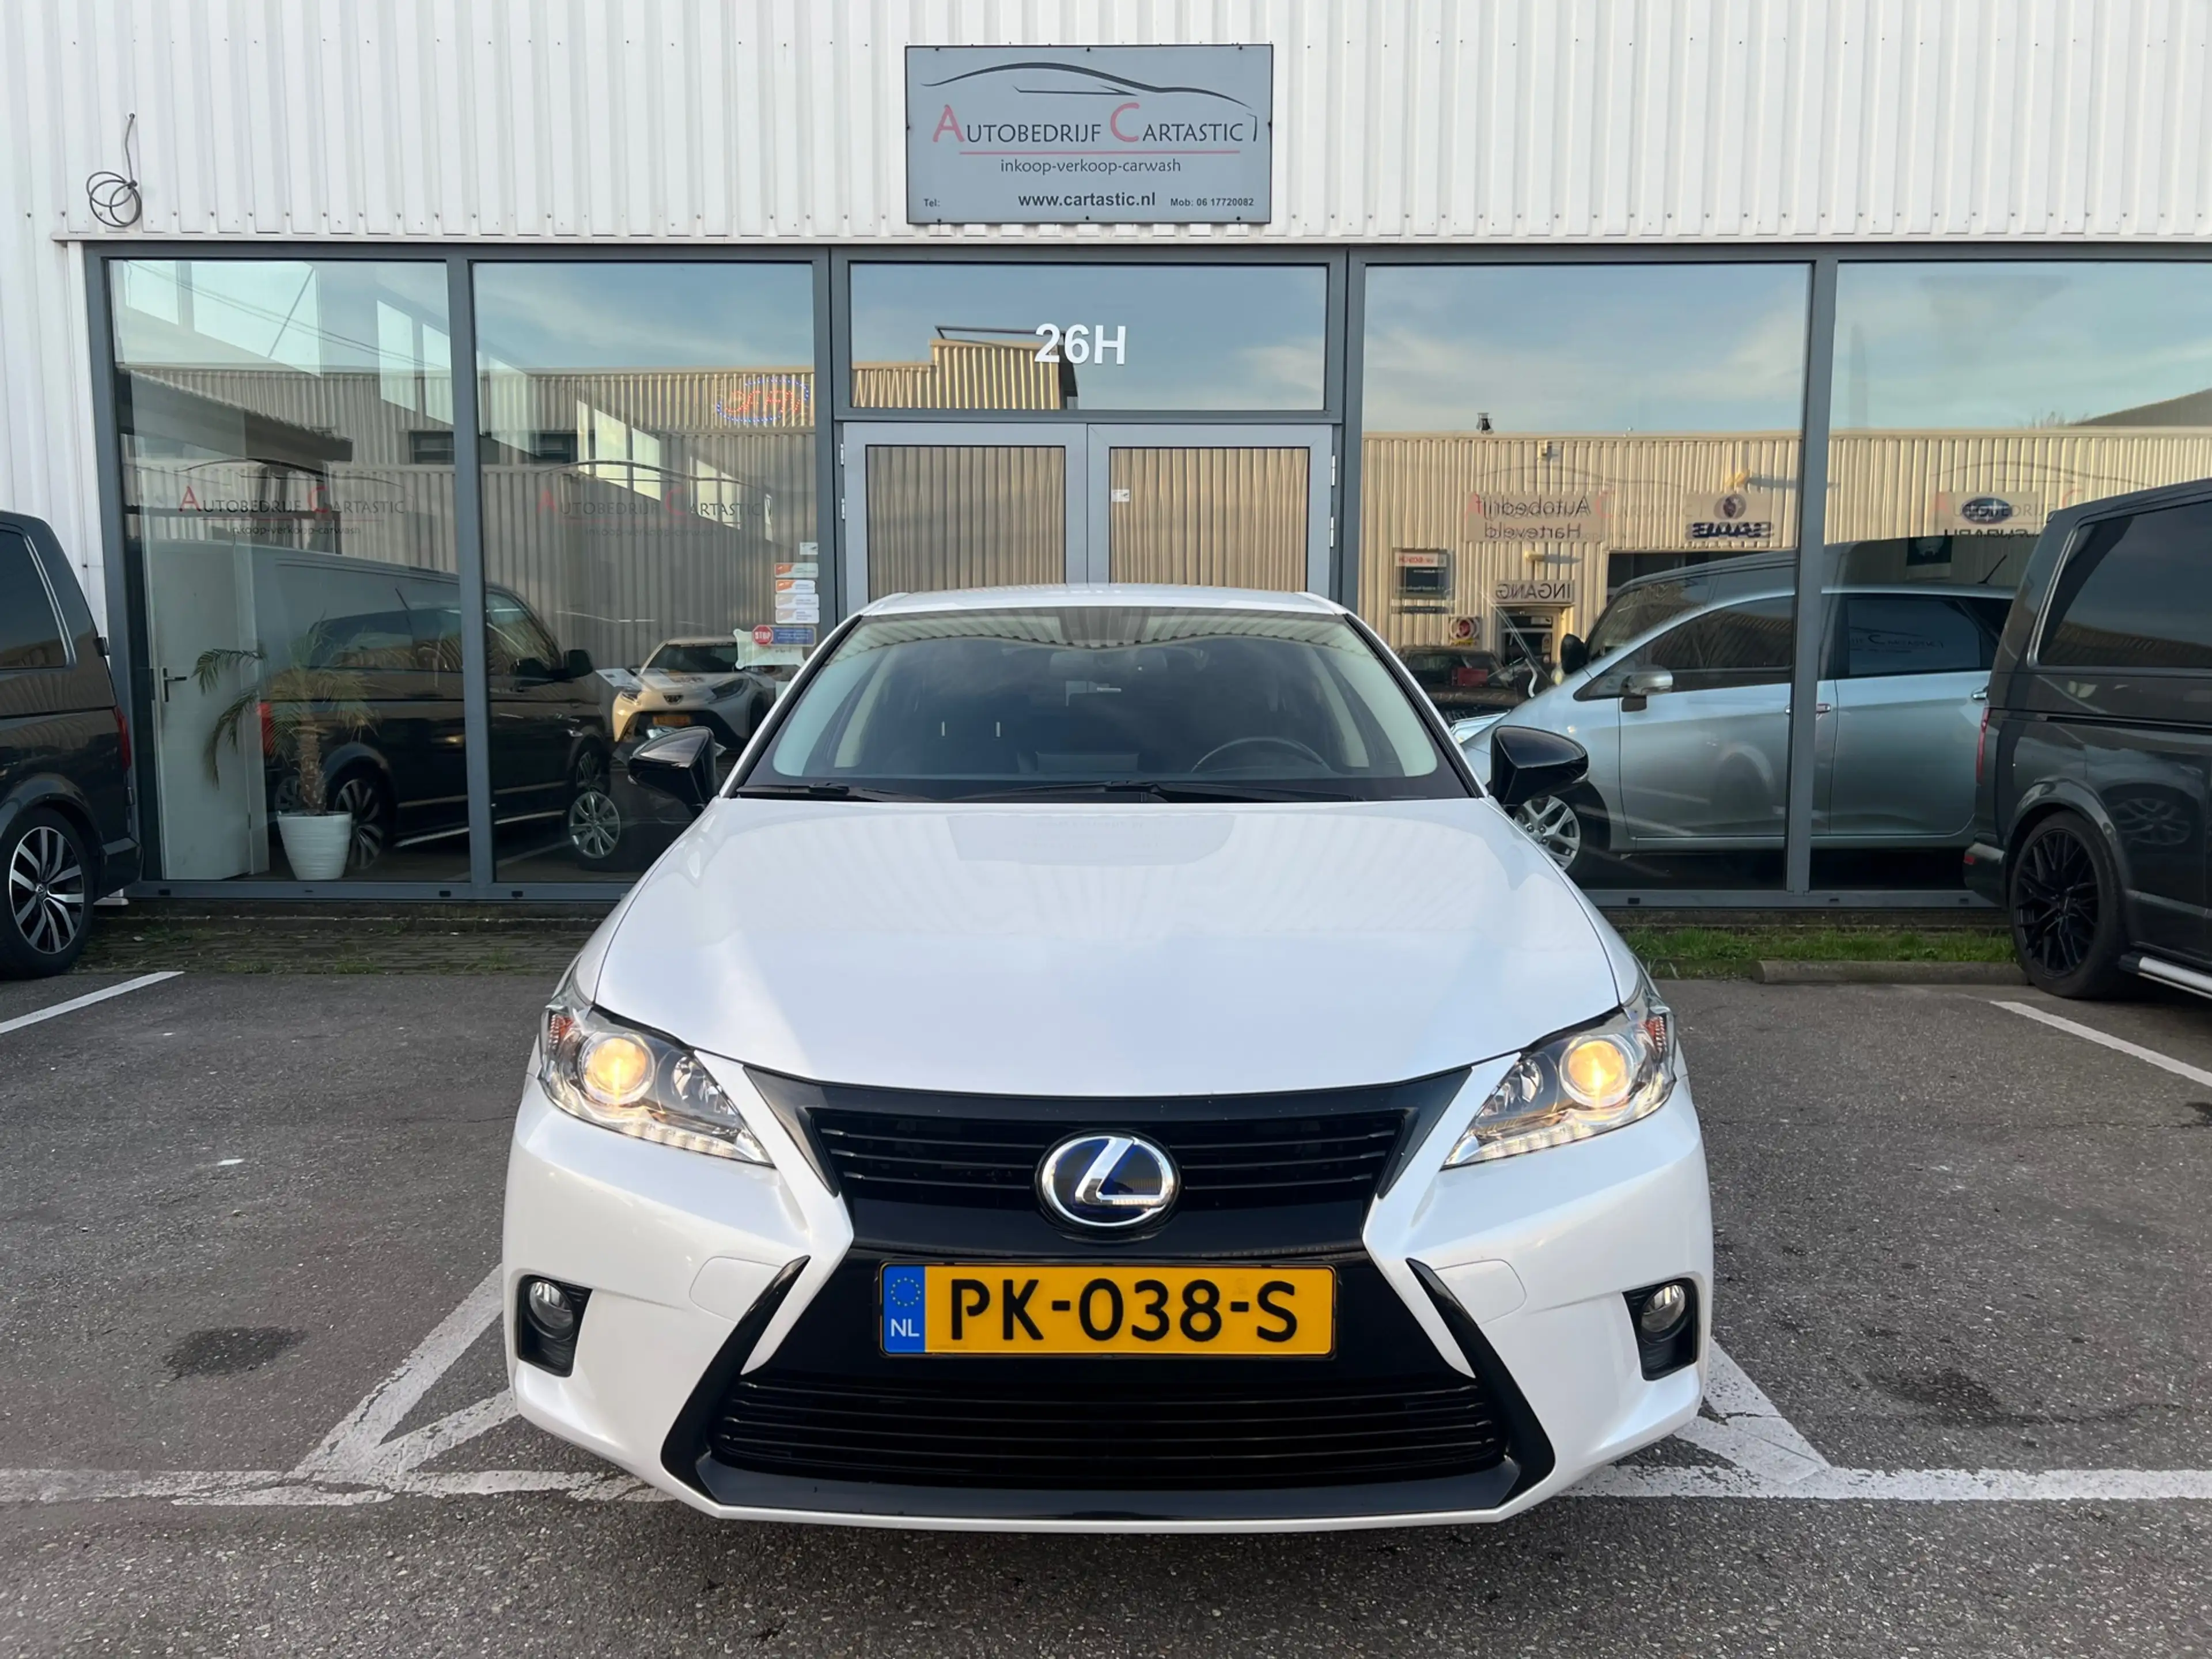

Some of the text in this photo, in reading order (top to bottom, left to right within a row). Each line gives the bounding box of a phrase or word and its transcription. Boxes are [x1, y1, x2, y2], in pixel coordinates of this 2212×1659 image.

[932, 103, 1243, 143] AUTOBEDRIJF CARTASTIC
[1000, 158, 1181, 175] inkoop-verkoop-carwash
[923, 192, 1255, 208] Tel: www.cartastic.nl Mob: 06 17720082
[1034, 323, 1126, 365] 26H
[179, 485, 405, 514] AUTOBEDRIJF CARTASTIC
[754, 631, 771, 640] STOP
[890, 1277, 1298, 1342] NL PK-038-S
